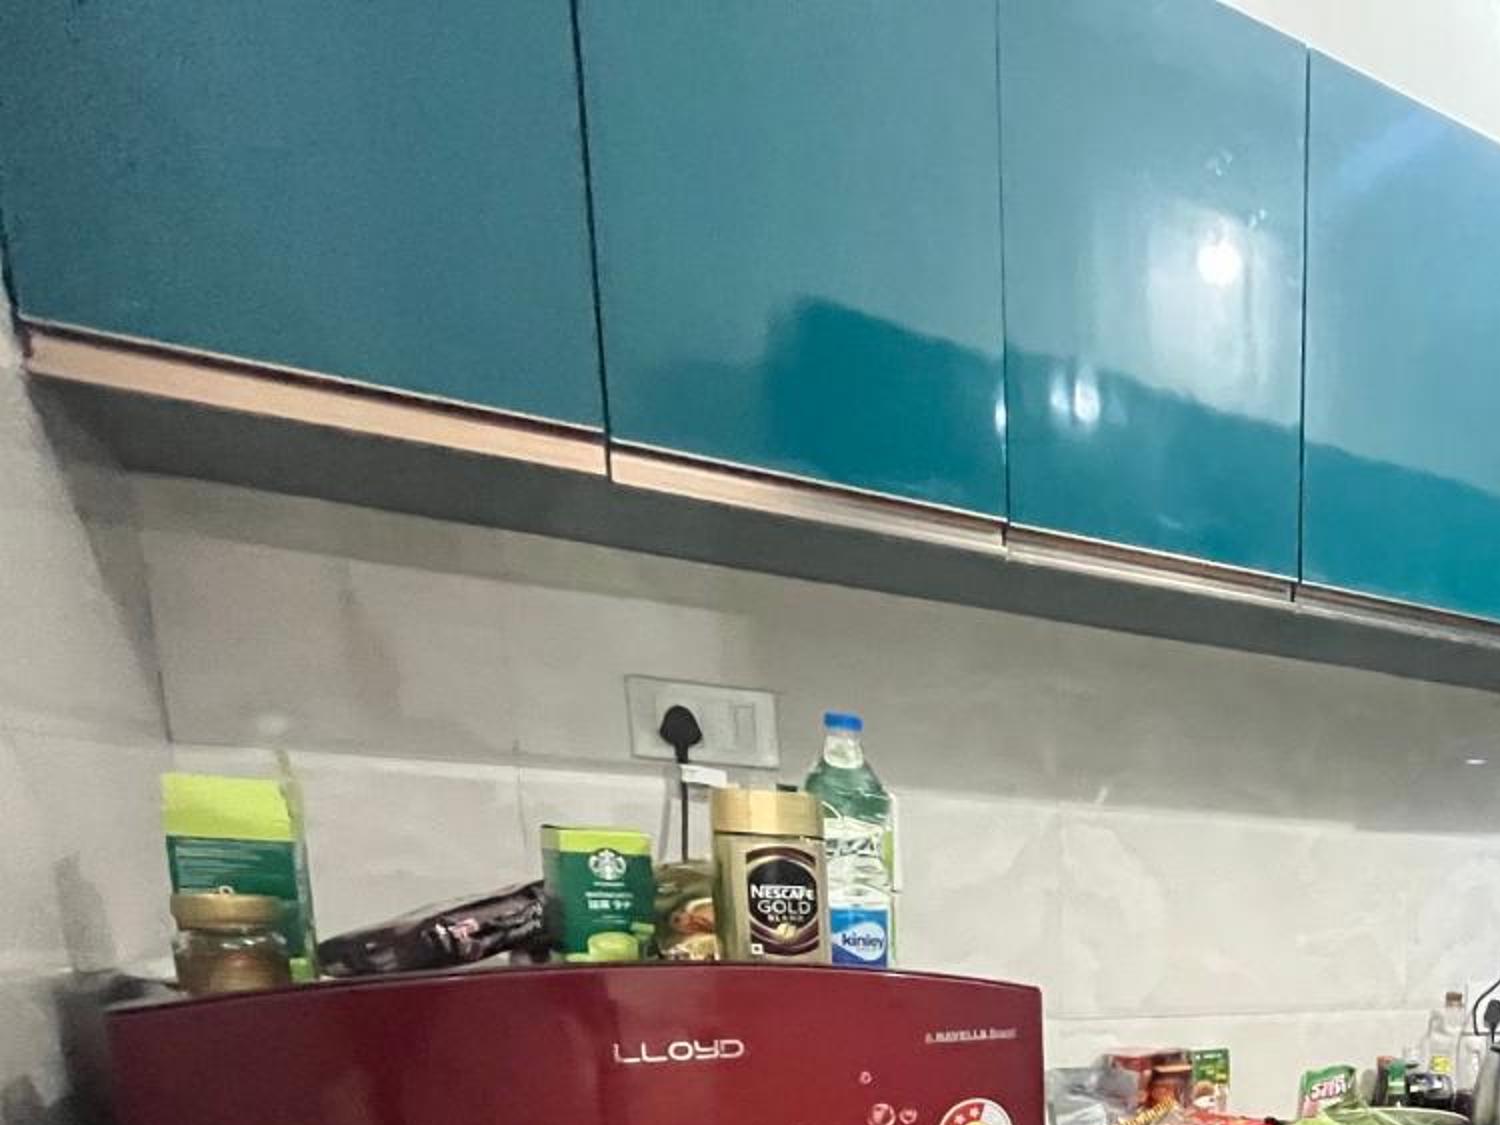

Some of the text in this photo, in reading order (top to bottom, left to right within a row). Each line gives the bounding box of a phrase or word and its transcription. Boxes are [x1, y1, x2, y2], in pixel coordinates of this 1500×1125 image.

[757, 899, 811, 915] GOLD
[842, 931, 884, 949] kinley
[613, 1039, 745, 1062] LLOYD
